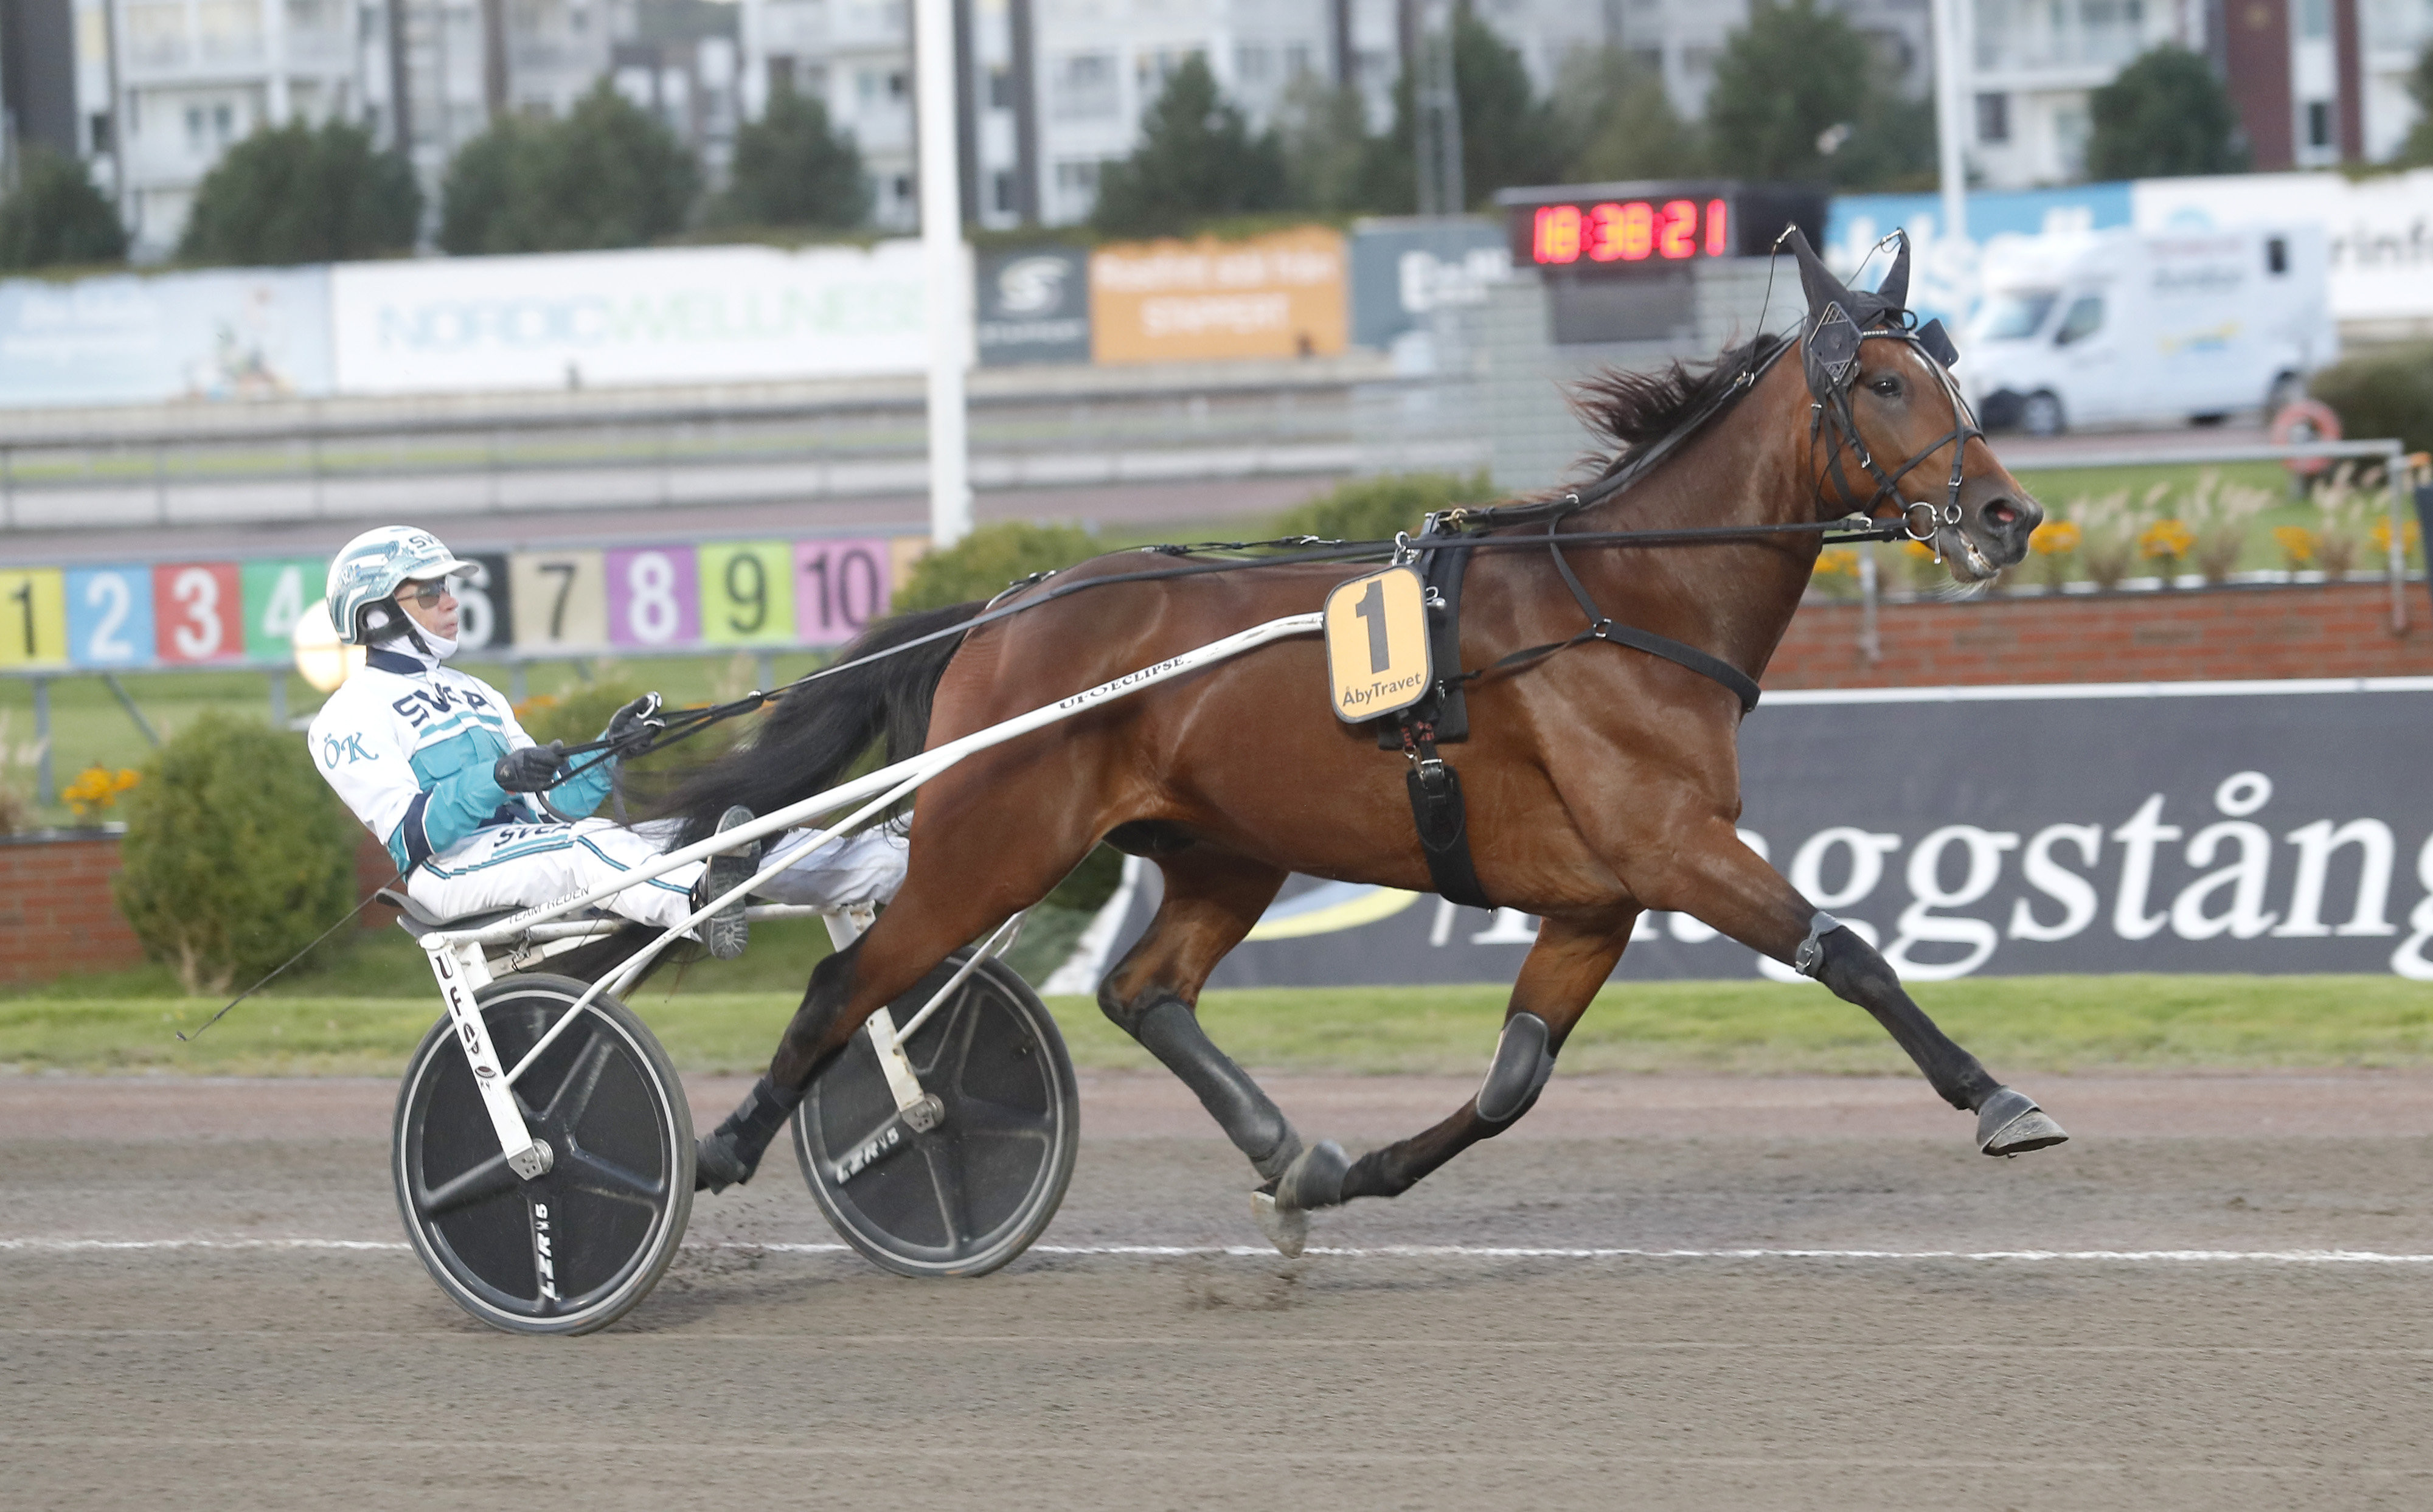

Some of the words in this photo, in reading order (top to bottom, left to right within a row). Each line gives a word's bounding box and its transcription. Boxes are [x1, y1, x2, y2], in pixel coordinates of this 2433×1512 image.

[1533, 199, 1726, 263] 18:38:21
[10, 581, 36, 657] 1
[86, 570, 134, 659] 2
[173, 567, 223, 658] 3
[262, 567, 304, 638] 4
[538, 563, 576, 639] 7
[627, 550, 679, 643] 8
[725, 552, 768, 635] 9
[808, 549, 880, 630] 10
[1355, 579, 1390, 675] 1
[1342, 673, 1421, 707] ÅbyTravet
[324, 732, 379, 769] ÖK
